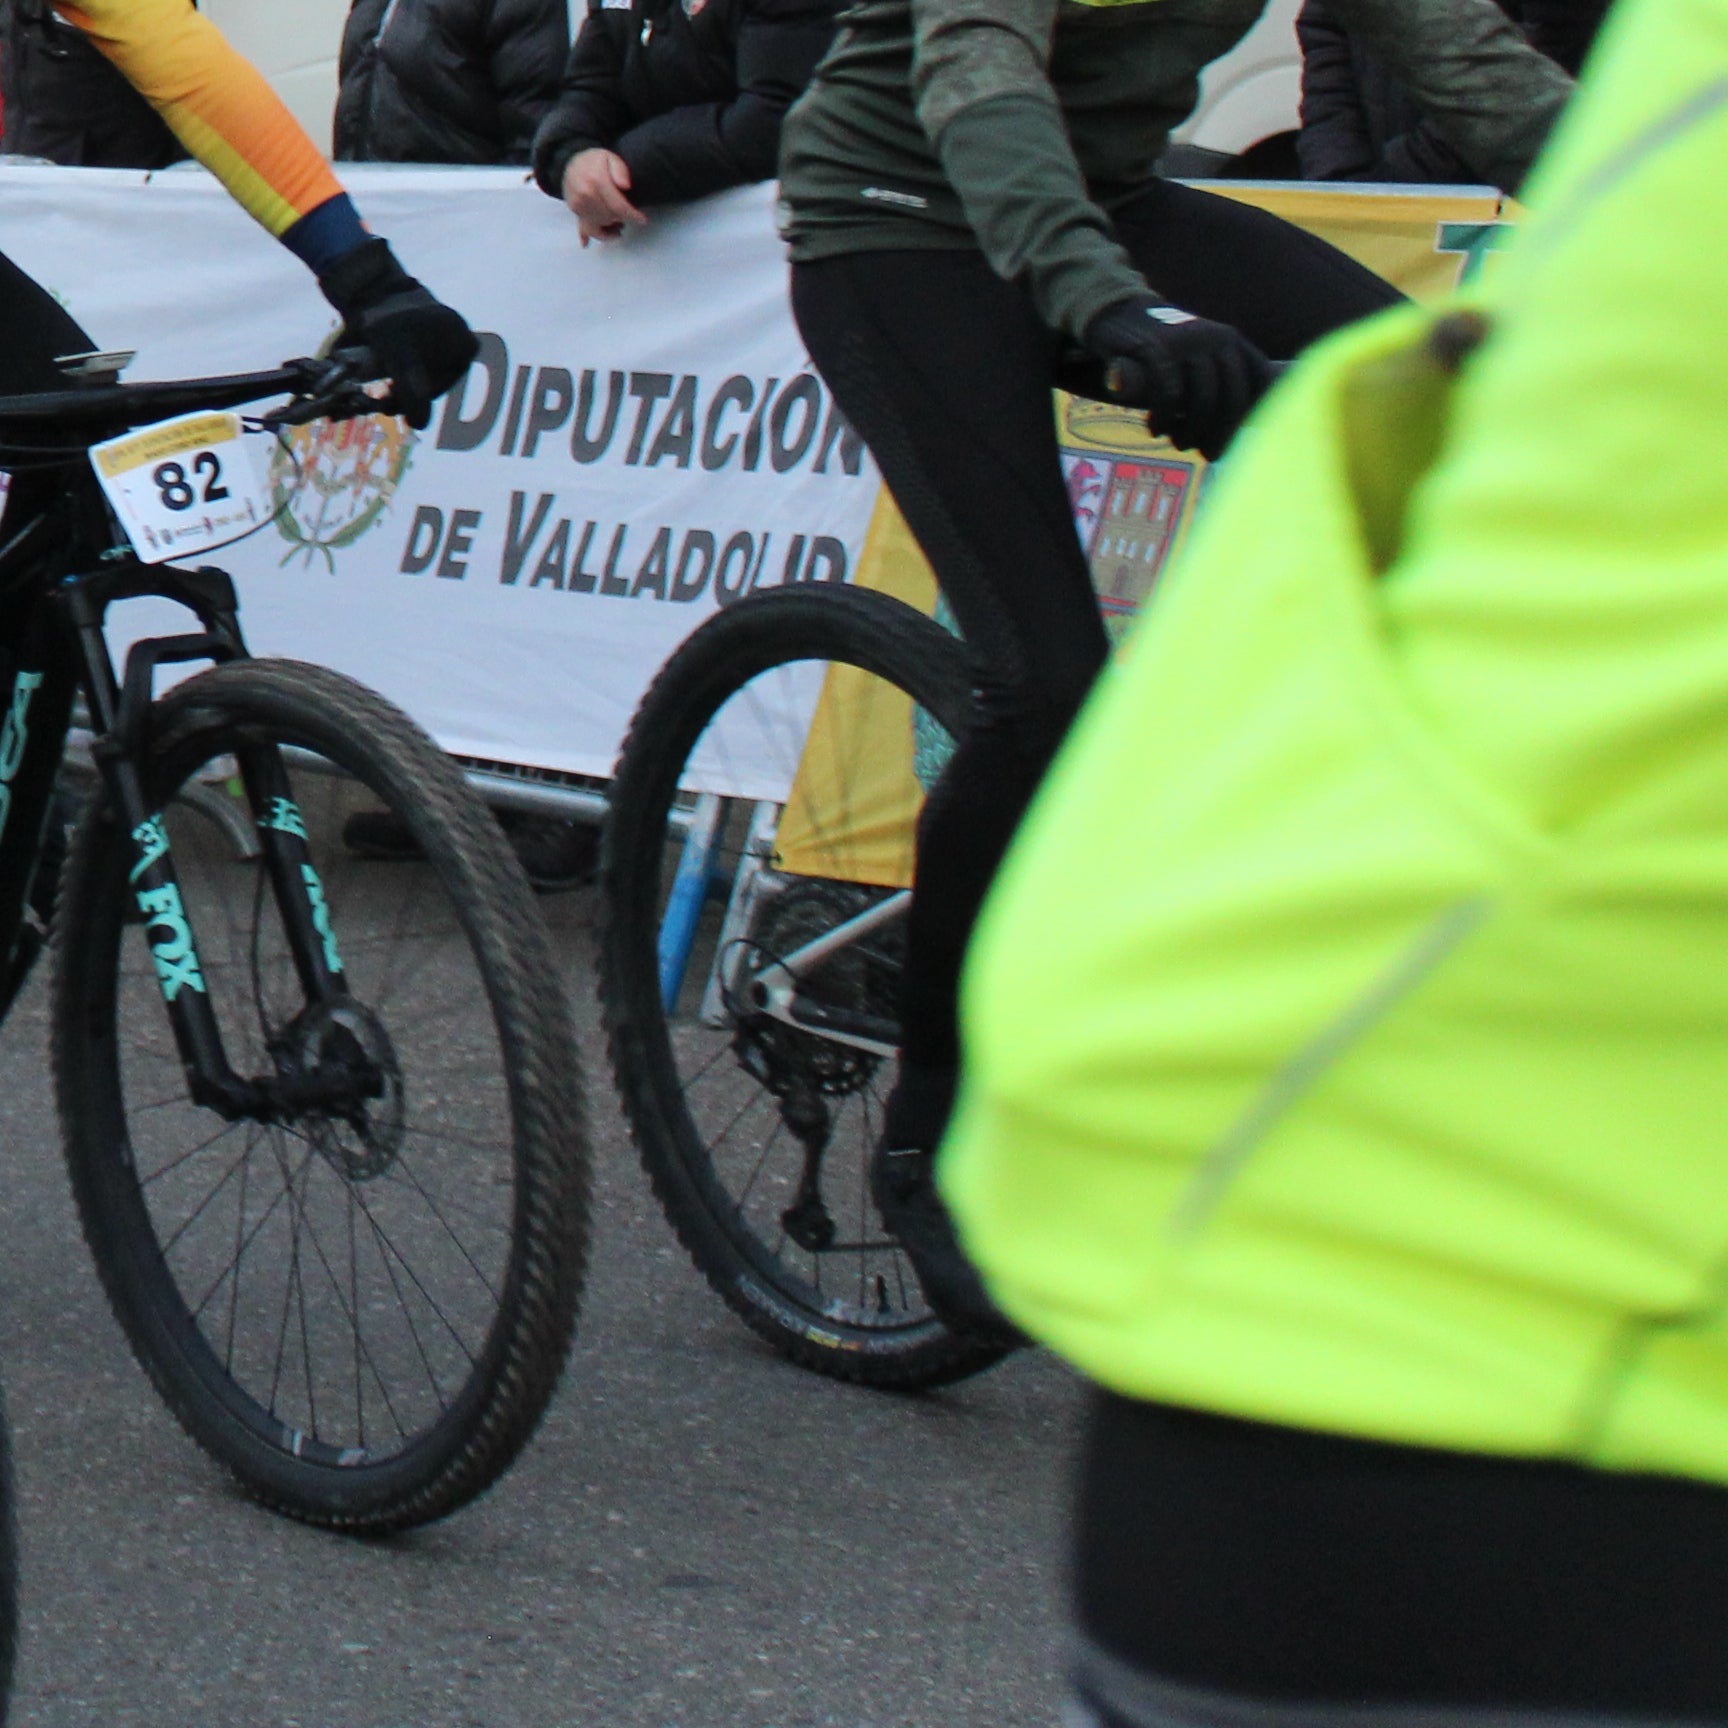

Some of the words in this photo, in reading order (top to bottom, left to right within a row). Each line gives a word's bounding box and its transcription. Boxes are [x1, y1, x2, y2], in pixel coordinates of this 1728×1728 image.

[153, 451, 231, 512] 82
[400, 504, 472, 581] DE
[498, 489, 848, 606] VALLADOLID
